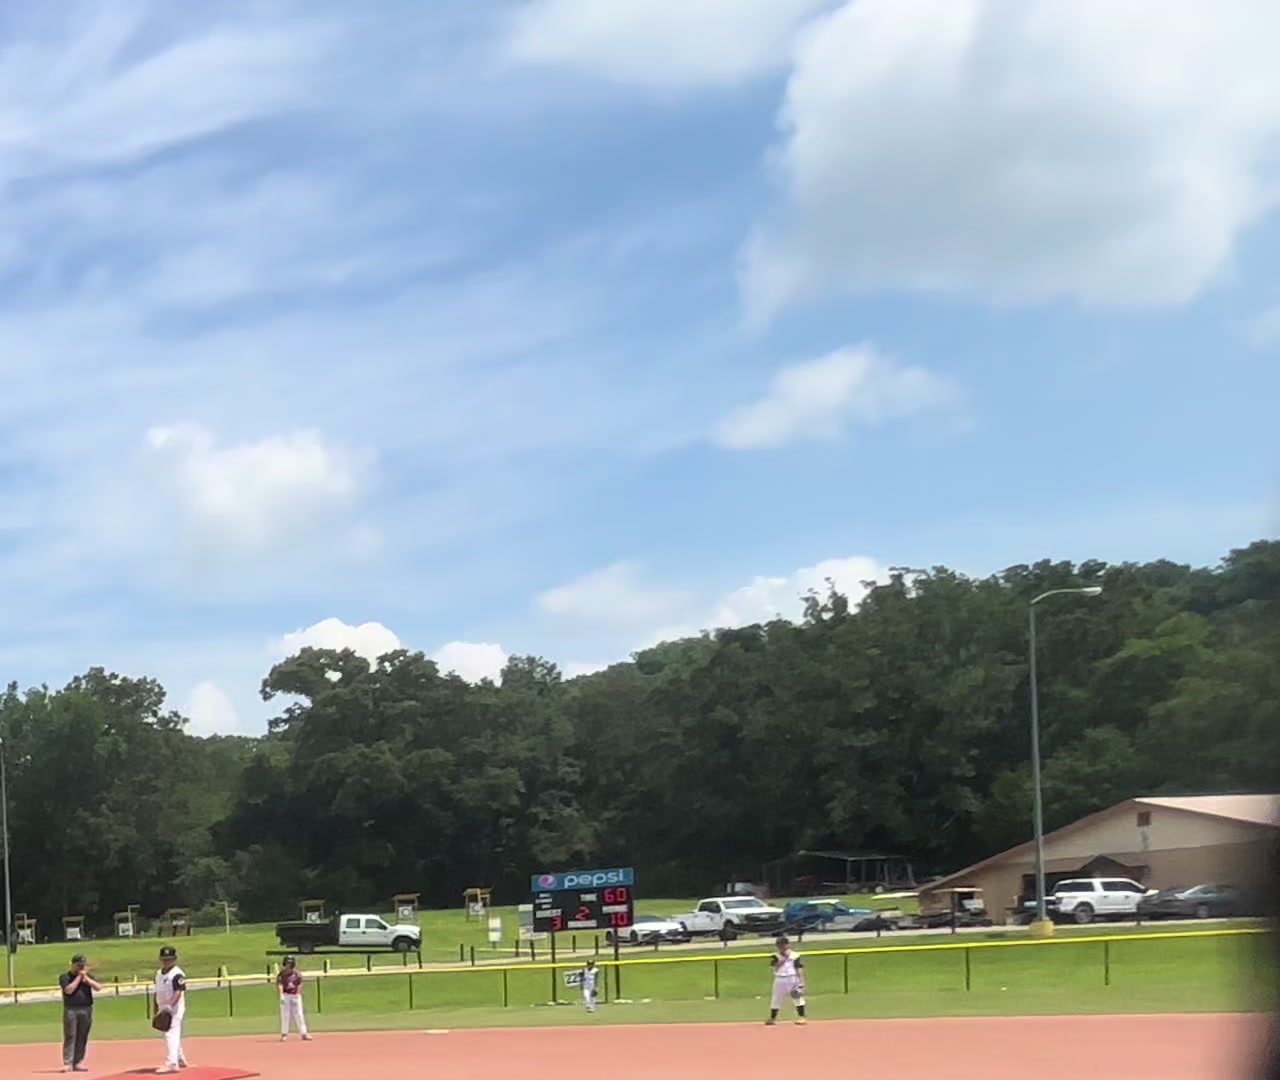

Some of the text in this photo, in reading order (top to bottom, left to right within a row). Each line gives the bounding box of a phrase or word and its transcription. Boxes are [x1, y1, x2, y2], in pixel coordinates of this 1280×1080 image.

[564, 869, 624, 888] pepsi
[604, 888, 627, 903] 60
[575, 906, 590, 919] 2
[552, 916, 562, 930] 3
